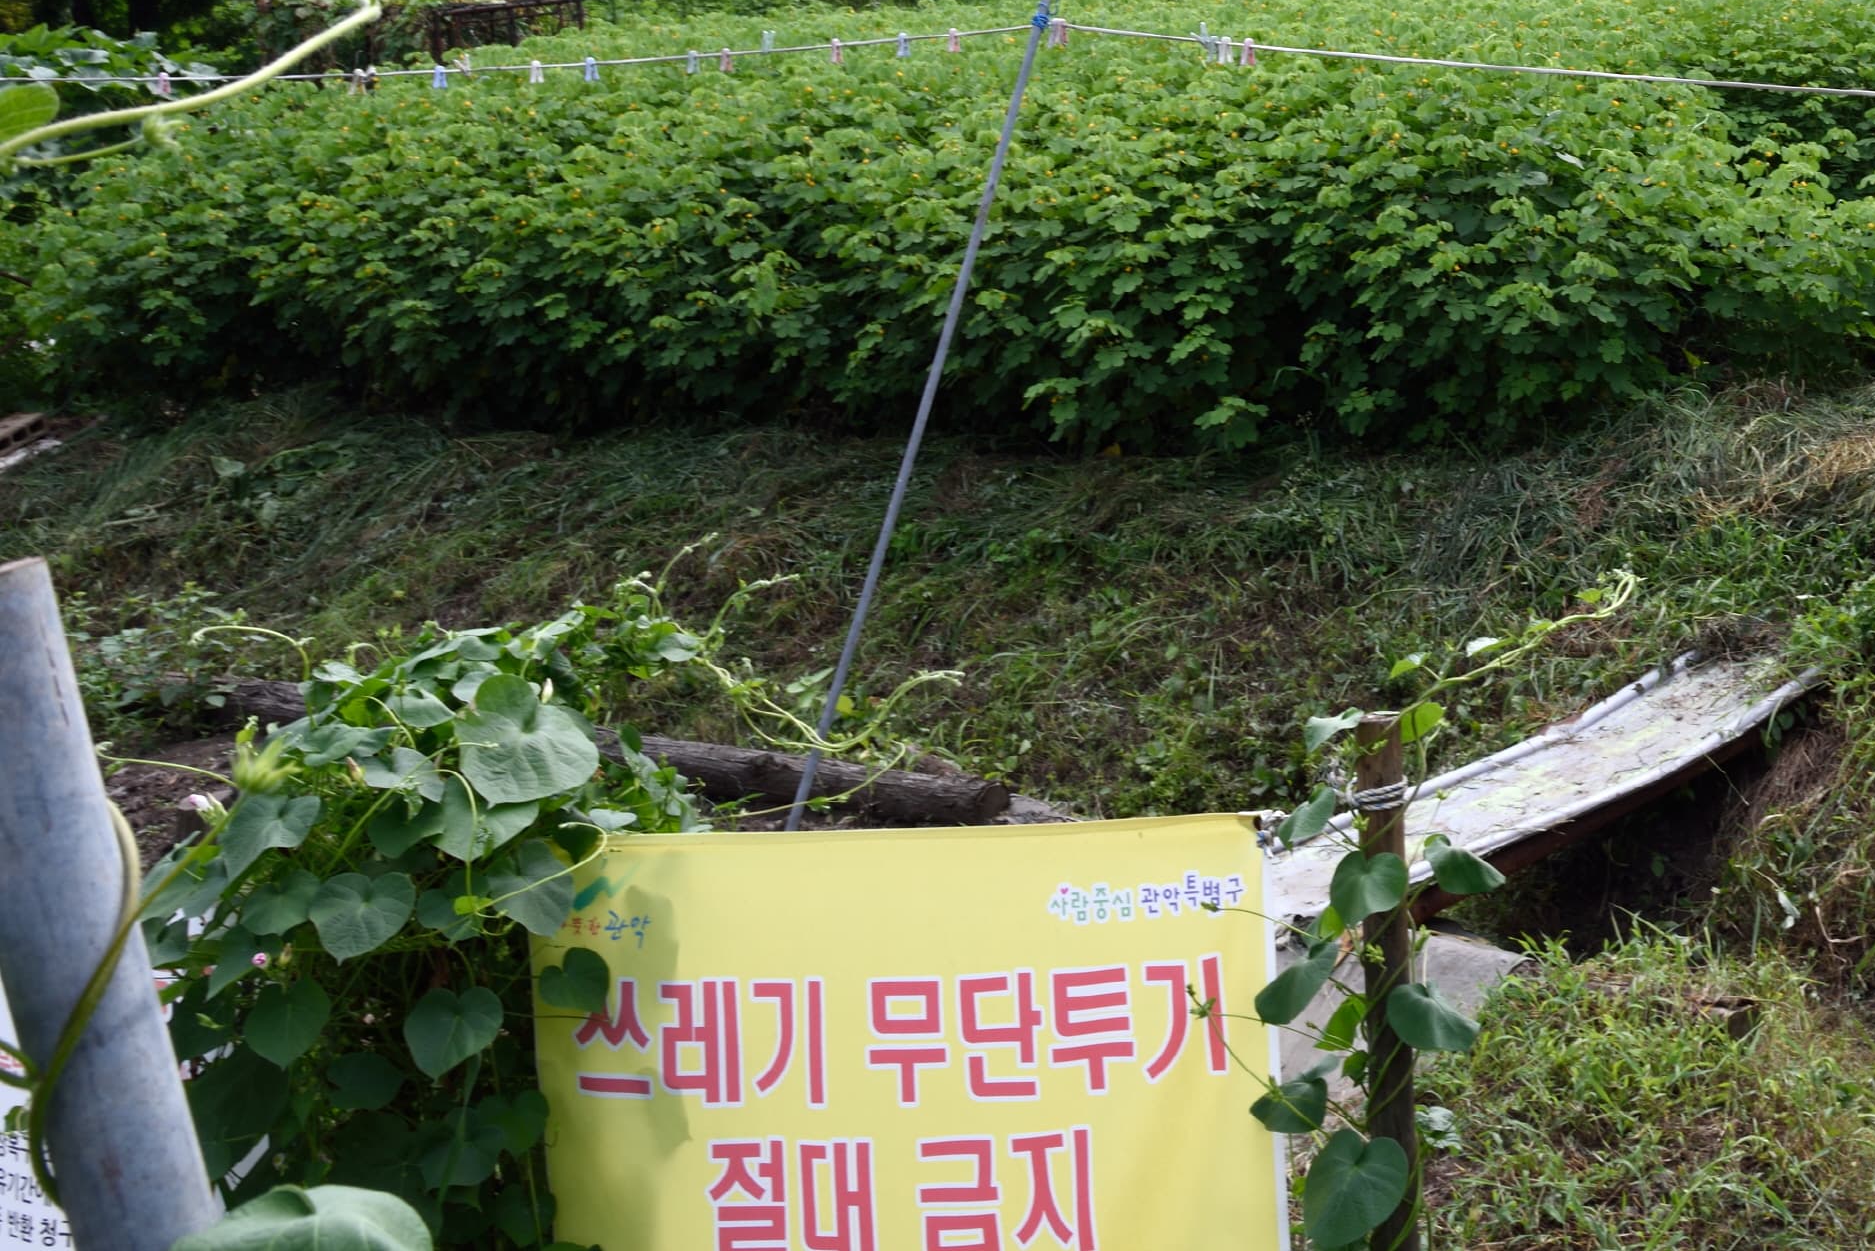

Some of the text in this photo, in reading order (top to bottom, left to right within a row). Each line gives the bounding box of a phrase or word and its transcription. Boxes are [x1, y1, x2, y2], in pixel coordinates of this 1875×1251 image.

[560, 909, 652, 949] 뜻한 관악
[1050, 887, 1131, 921] 사람중심
[574, 955, 1227, 1105] 쓰레기 무단투기
[708, 1128, 1098, 1251] 절대 금지
